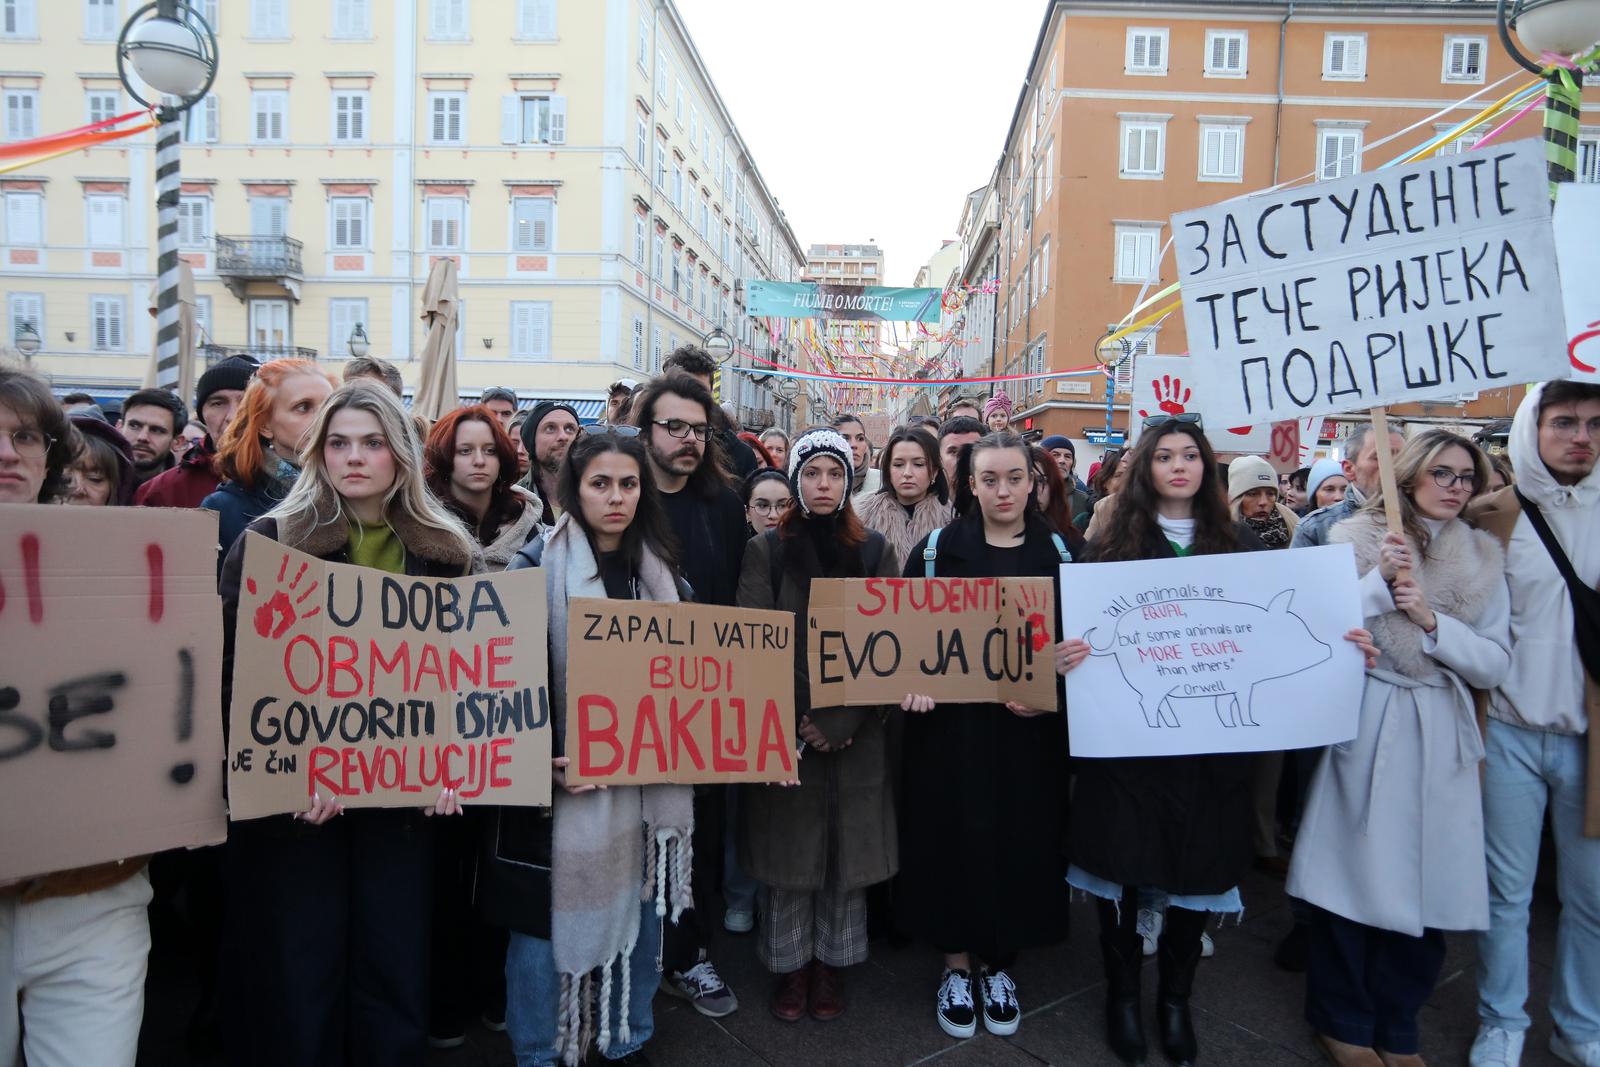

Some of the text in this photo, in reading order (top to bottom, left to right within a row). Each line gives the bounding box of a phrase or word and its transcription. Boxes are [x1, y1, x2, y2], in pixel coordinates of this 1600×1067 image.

[793, 293, 834, 309] FIUME
[843, 295, 895, 311] MORTE!
[1195, 239, 1530, 350] ТЕЧЕ РИЈЕКА
[1240, 312, 1508, 414] ПОДРШКЕ
[326, 572, 510, 633] U DOBA
[1136, 584, 1200, 604] animals
[1203, 586, 1225, 598] are
[1142, 603, 1187, 621] EQUAL,
[583, 614, 789, 650] ZAPALI VATRU
[1117, 623, 1253, 647] but some animals are
[283, 634, 517, 698] OBMANE
[919, 628, 969, 676] JA
[1137, 640, 1243, 664] MORE EQUAL
[1156, 665, 1188, 676] than
[650, 655, 734, 693] BUDI
[1184, 680, 1226, 695] Orwell
[250, 696, 435, 746] GOVORITI
[577, 694, 792, 777] BAKLJA
[231, 738, 515, 798] JE ČIN REVOLUCIJE
